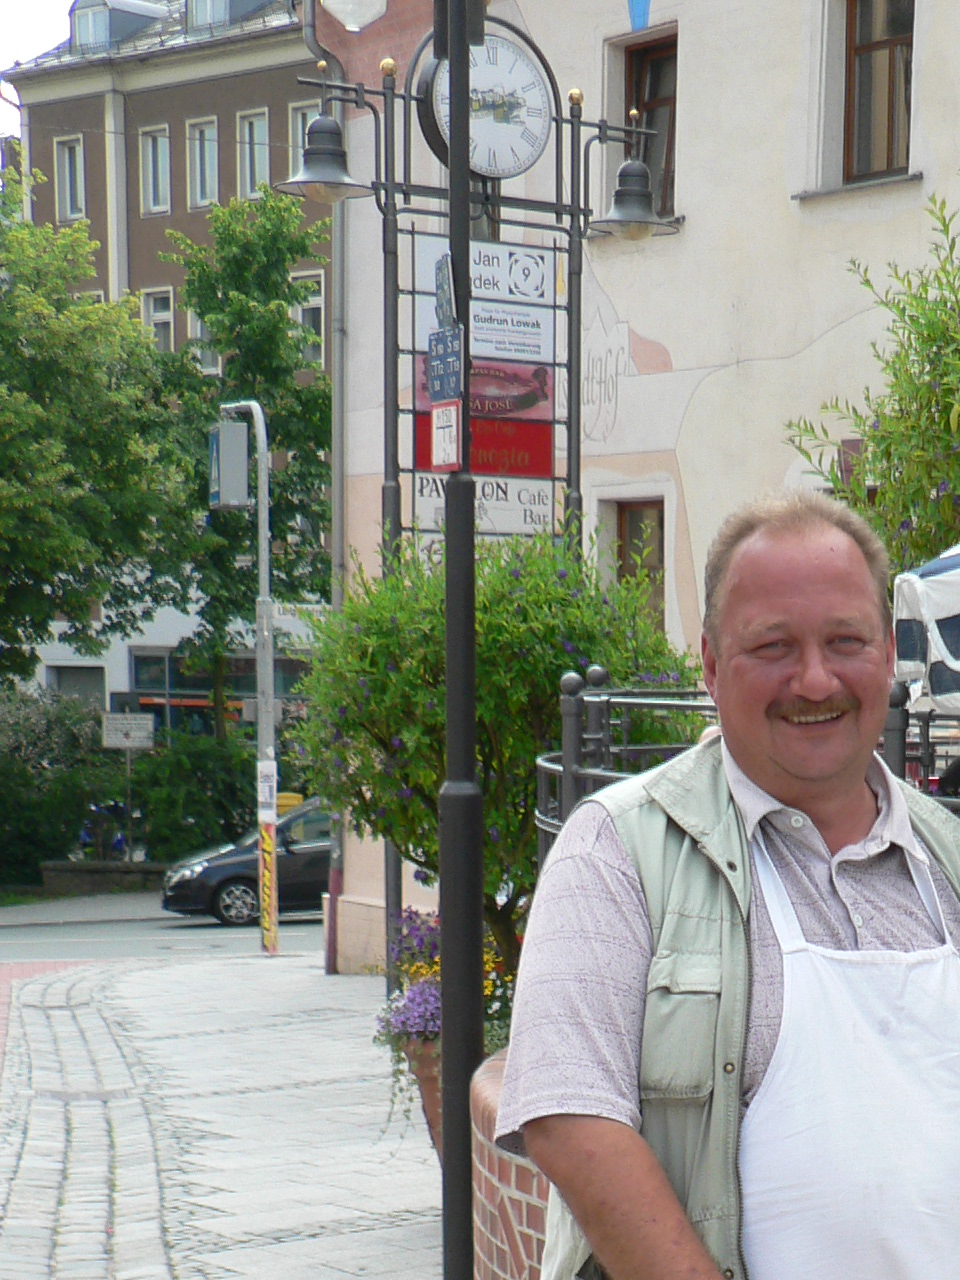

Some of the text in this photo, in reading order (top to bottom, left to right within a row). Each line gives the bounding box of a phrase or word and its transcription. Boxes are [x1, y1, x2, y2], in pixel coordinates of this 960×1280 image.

[473, 250, 500, 268] Jan
[471, 273, 500, 291] dek
[473, 314, 541, 329] Gudrun Lowak
[523, 508, 549, 526] Bar
